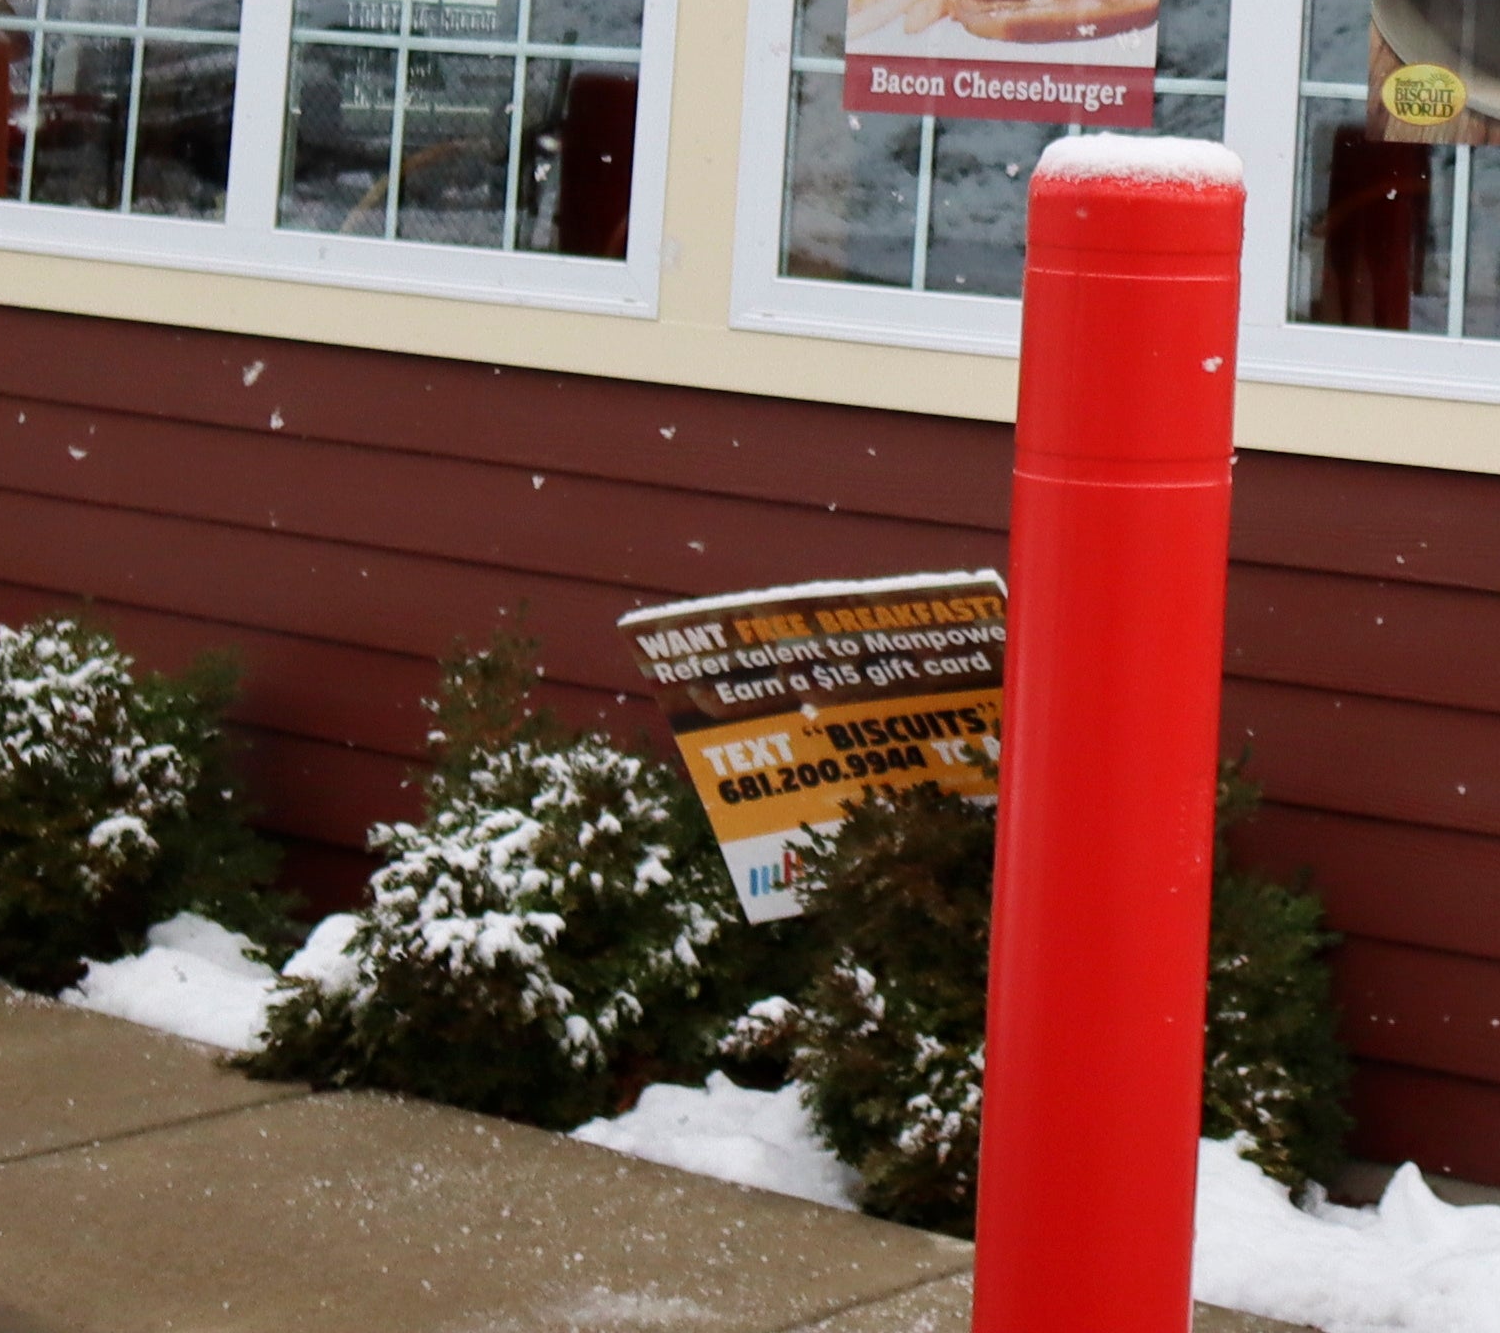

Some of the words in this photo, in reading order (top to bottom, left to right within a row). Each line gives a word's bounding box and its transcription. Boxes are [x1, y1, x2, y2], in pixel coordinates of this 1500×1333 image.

[870, 66, 945, 96] Bacon
[953, 71, 1127, 112] Cheeseburger
[1394, 86, 1455, 104] BISCUIT
[1394, 101, 1455, 118] WORLD
[636, 622, 728, 661] WANT
[733, 613, 813, 645] FREE
[815, 596, 1005, 633] BREAKFAST?
[653, 653, 732, 684] Refer
[734, 639, 827, 669] talent
[826, 635, 860, 658] to
[863, 625, 1007, 655] Manpowe
[715, 677, 786, 706] Earn
[788, 673, 811, 693] a
[812, 661, 861, 691] $15
[865, 657, 920, 686] gift
[923, 651, 992, 676] card
[702, 732, 795, 775] TEXT
[717, 745, 929, 805] 681.200.9944
